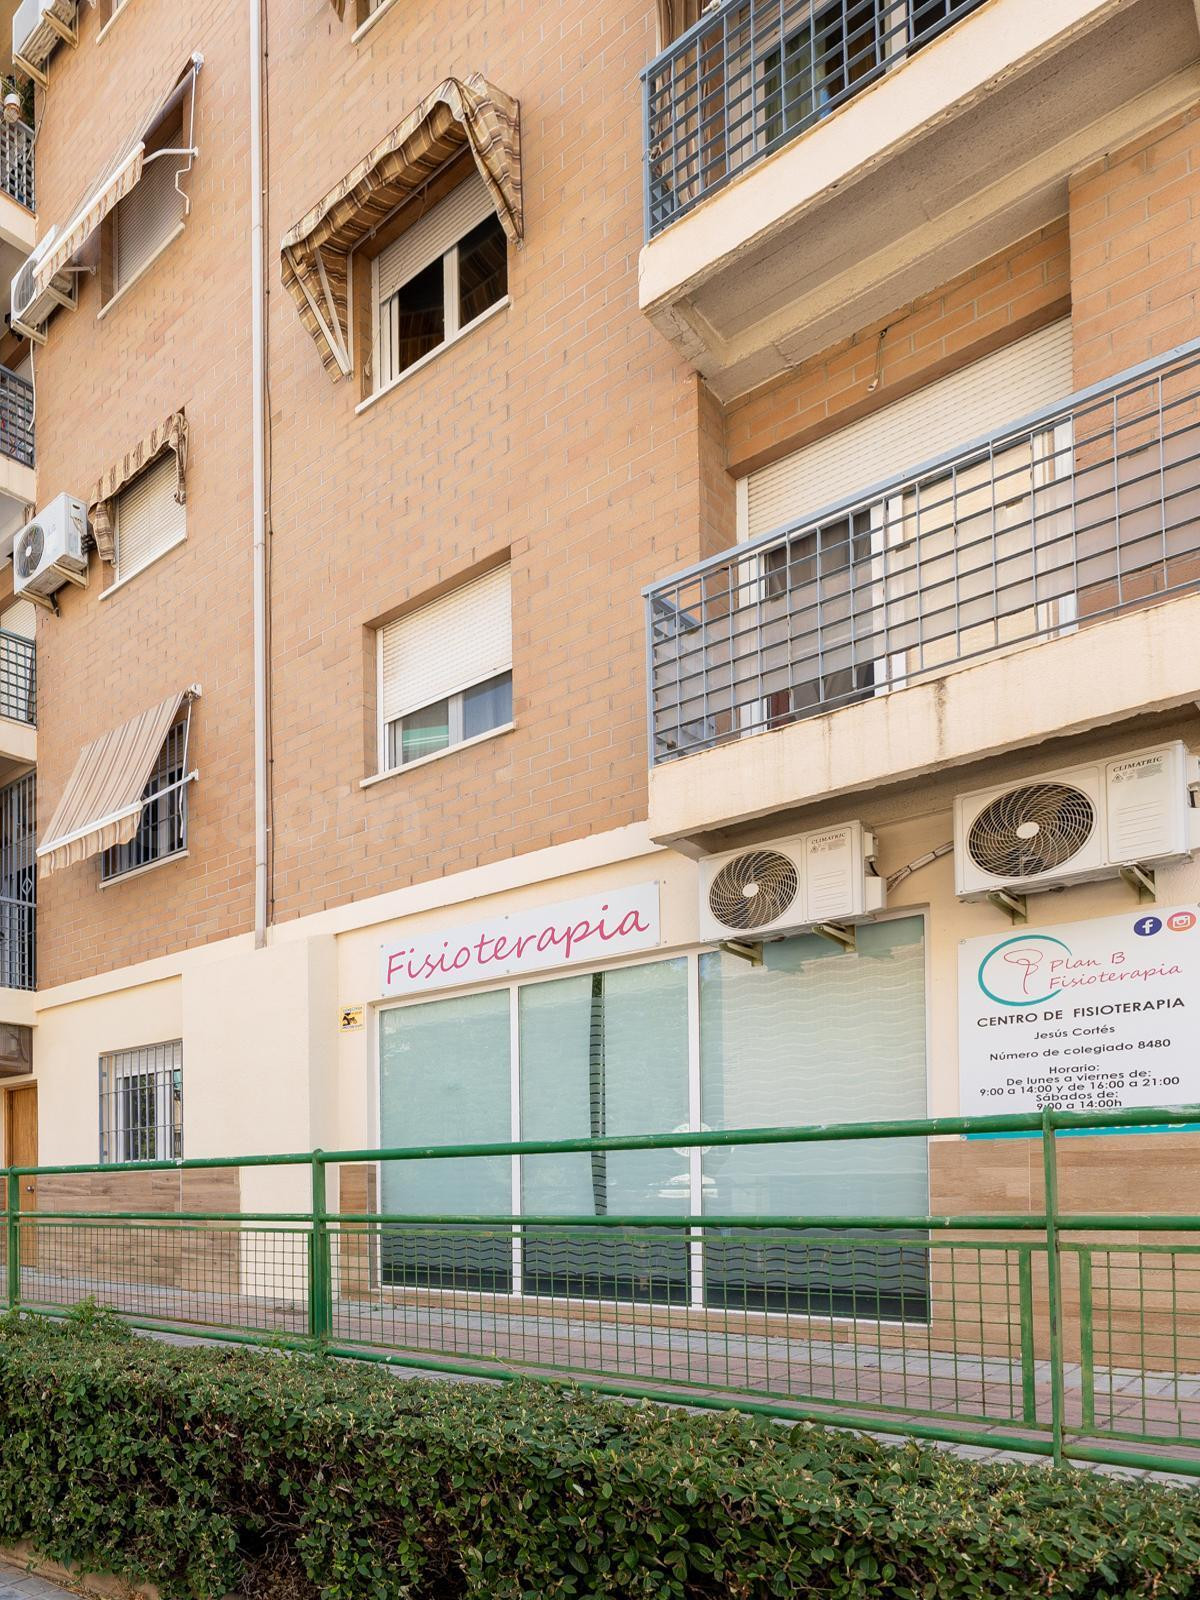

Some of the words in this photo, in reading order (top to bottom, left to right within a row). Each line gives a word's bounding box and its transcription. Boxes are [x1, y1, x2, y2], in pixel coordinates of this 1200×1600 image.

[1113, 757, 1162, 772] CLIMATRIC
[811, 833, 846, 844] CLIMATRIC
[386, 904, 650, 985] Fisioterapia
[1050, 958, 1100, 973] Plan
[1111, 951, 1126, 965] B
[1049, 964, 1183, 990] Fisioterapia
[977, 1013, 1038, 1028] CENTRO
[1044, 1010, 1063, 1021] DE
[1073, 997, 1186, 1018] FISIOTERAPIA
[1034, 1027, 1068, 1041] Jesús
[1072, 1025, 1116, 1037] Cortés
[990, 1051, 1039, 1062] Número
[1042, 1048, 1060, 1058] de
[1063, 1043, 1134, 1058] colegiado
[1137, 1038, 1171, 1051] 8480
[1006, 1078, 1023, 1086] De
[1026, 1076, 1060, 1085] lunes
[1076, 1072, 1124, 1082] viernes
[1128, 1069, 1152, 1078] de:
[1049, 1063, 1100, 1075] Horario:
[979, 1087, 1004, 1097] 9:00
[1007, 1088, 1016, 1096] a
[1020, 1084, 1052, 1094] 14:00
[1056, 1084, 1064, 1094] y
[1067, 1082, 1085, 1091] de
[1090, 1079, 1125, 1090] 16:00
[1128, 1079, 1138, 1087] a
[1142, 1076, 1180, 1087] 21:00
[1035, 1092, 1093, 1102] Sábados
[1096, 1090, 1119, 1099] de:
[1036, 1102, 1062, 1110] 9:00
[1066, 1101, 1075, 1109] a
[1080, 1099, 1122, 1109] 14:00h
